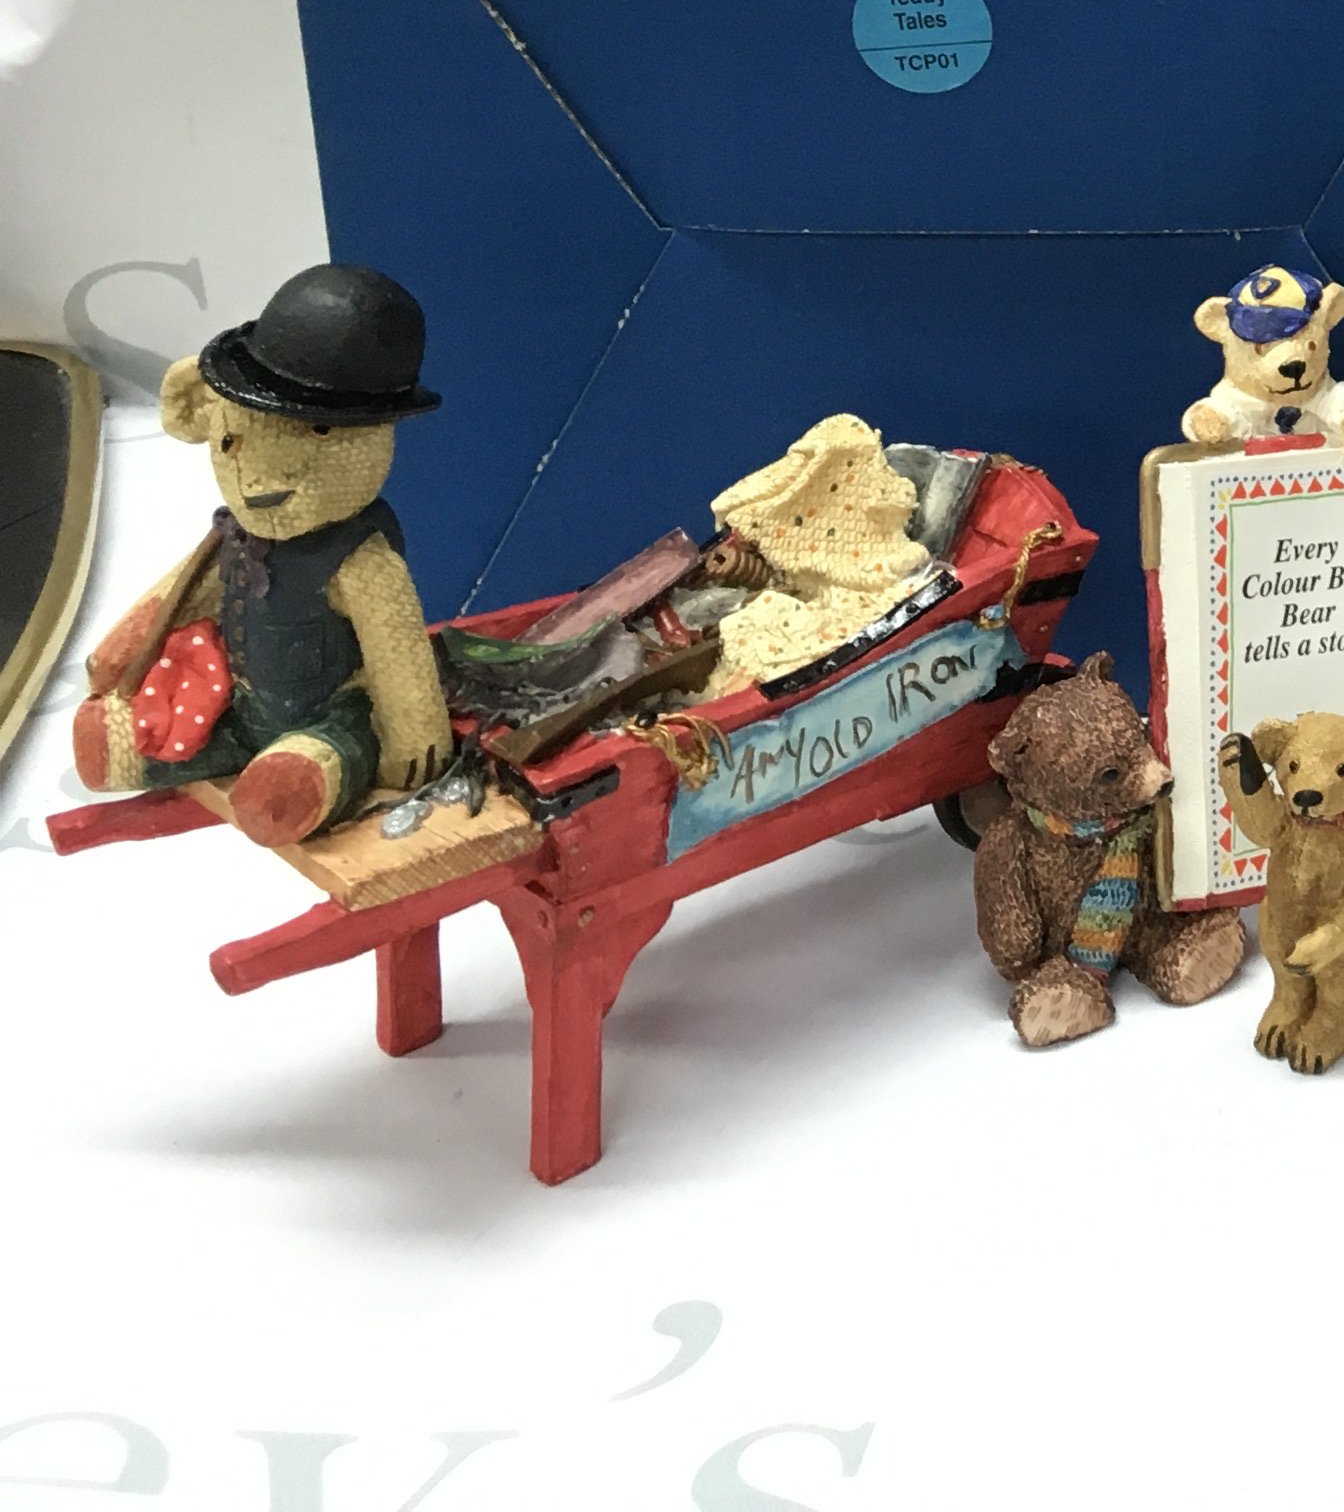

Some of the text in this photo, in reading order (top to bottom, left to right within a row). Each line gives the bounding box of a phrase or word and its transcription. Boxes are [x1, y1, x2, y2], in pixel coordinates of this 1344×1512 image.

[893, 10, 948, 31] Tales
[894, 52, 960, 72] TCP01
[1274, 538, 1339, 565] Every
[1242, 571, 1321, 600] Colour
[1280, 602, 1337, 628] Bear
[1244, 635, 1291, 664] tells
[1297, 638, 1311, 656] a
